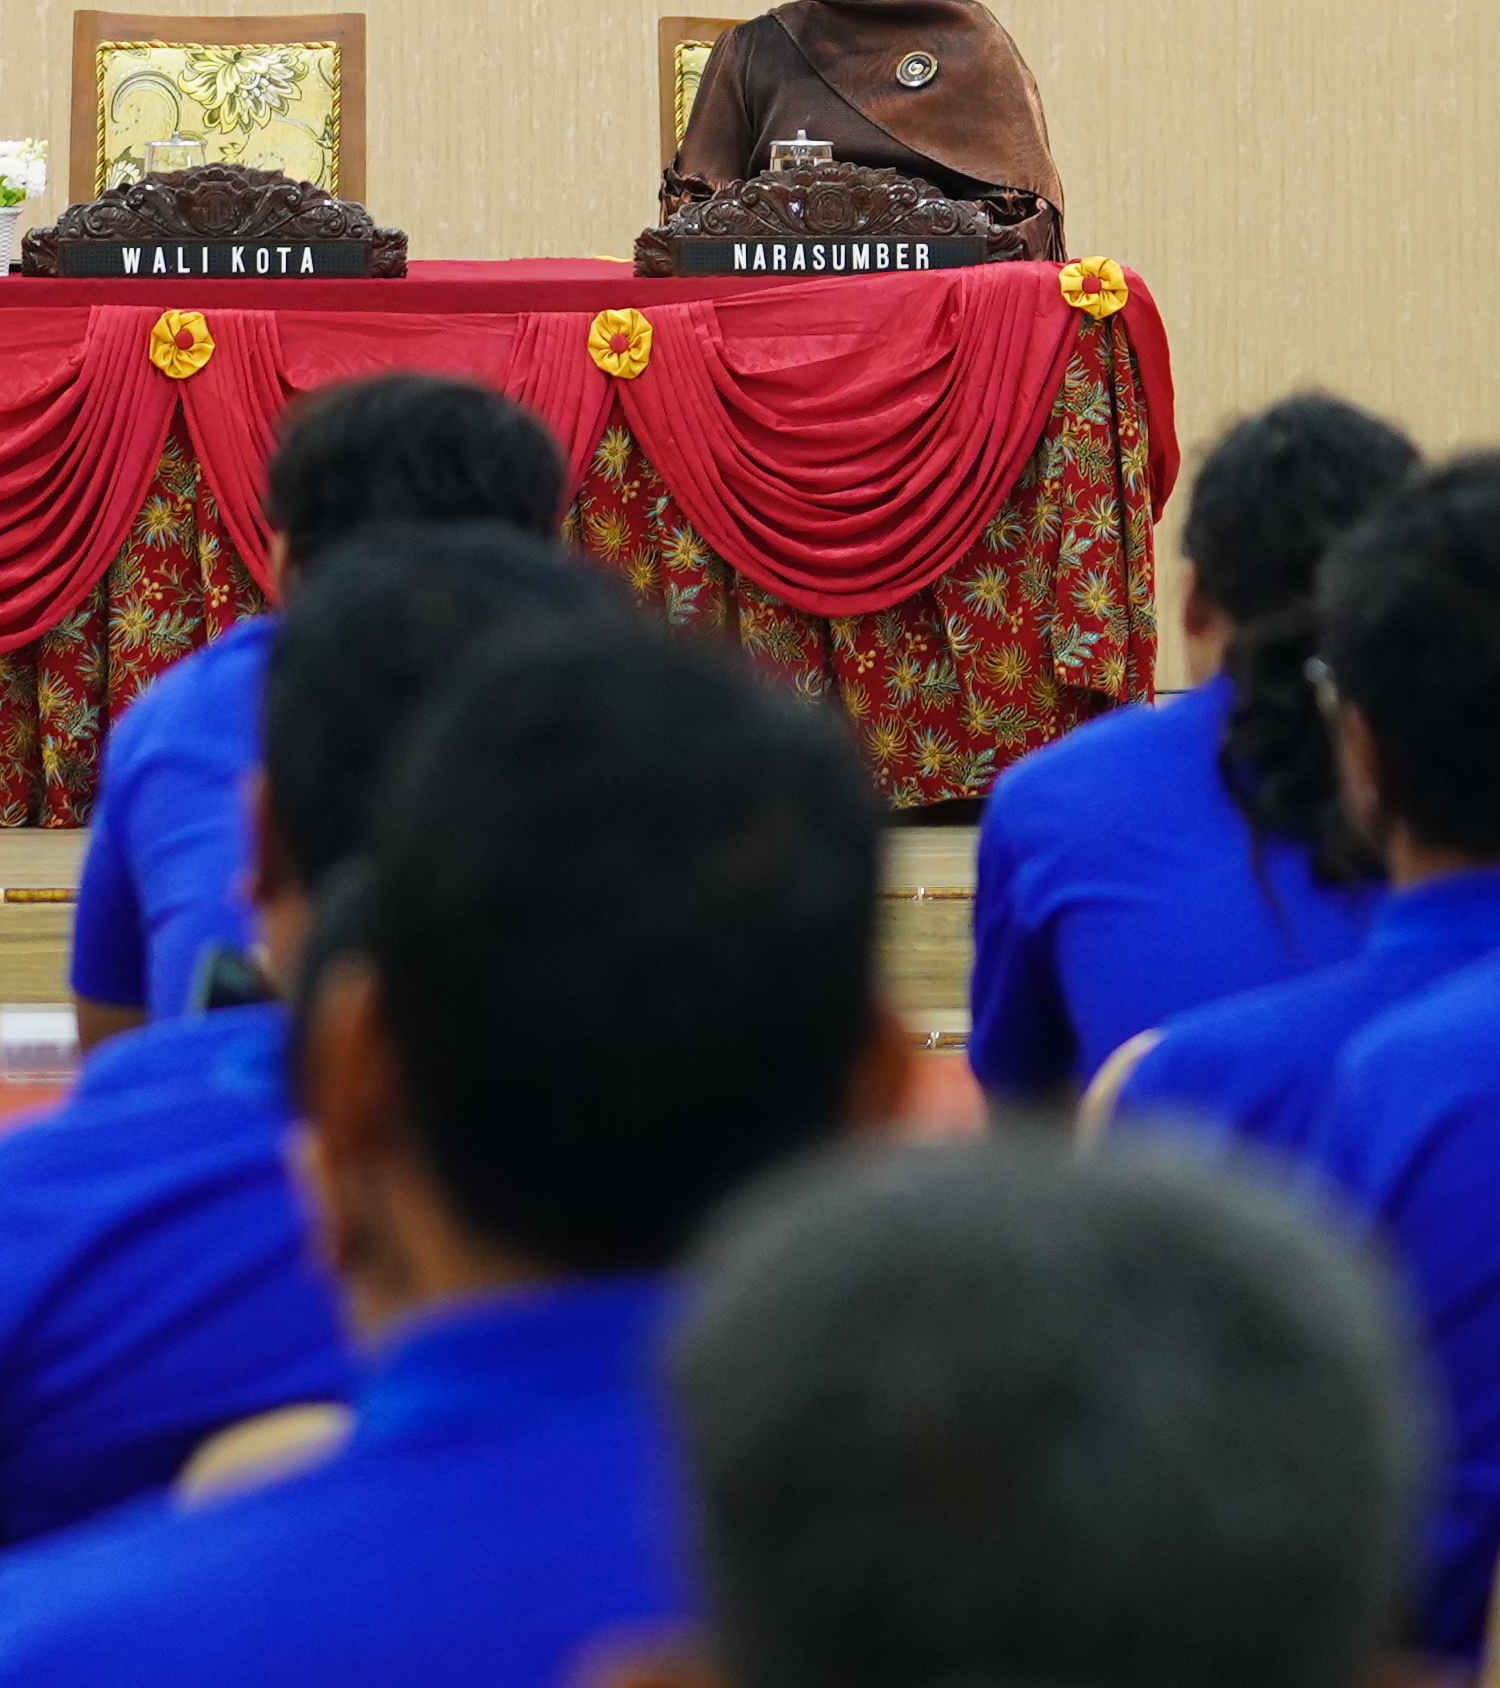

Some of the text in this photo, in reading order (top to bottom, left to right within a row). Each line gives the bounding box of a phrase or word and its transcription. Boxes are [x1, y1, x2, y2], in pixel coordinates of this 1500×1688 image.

[122, 246, 315, 274] WALI KOTA
[733, 243, 931, 270] NARASUMBER
